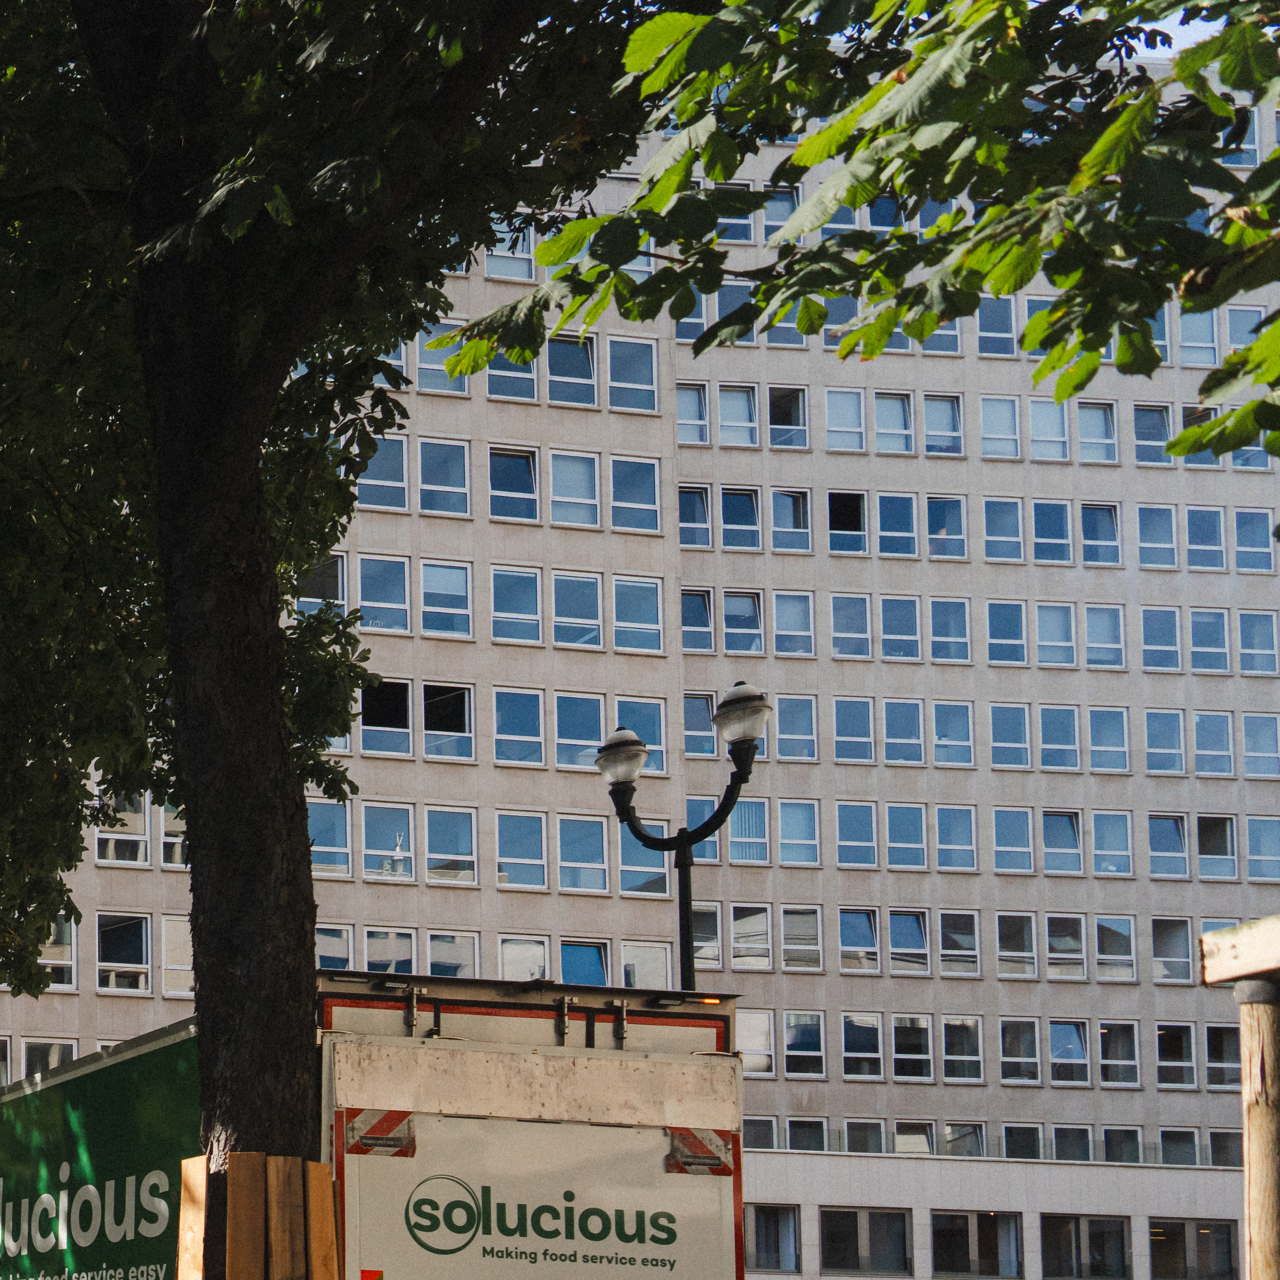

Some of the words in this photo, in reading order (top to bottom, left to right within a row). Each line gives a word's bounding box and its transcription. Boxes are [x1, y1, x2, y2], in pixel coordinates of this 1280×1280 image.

[411, 1185, 678, 1245] solucious
[482, 1246, 537, 1264] Making
[542, 1248, 578, 1263] food
[582, 1252, 637, 1266] service
[641, 1256, 677, 1272] easy
